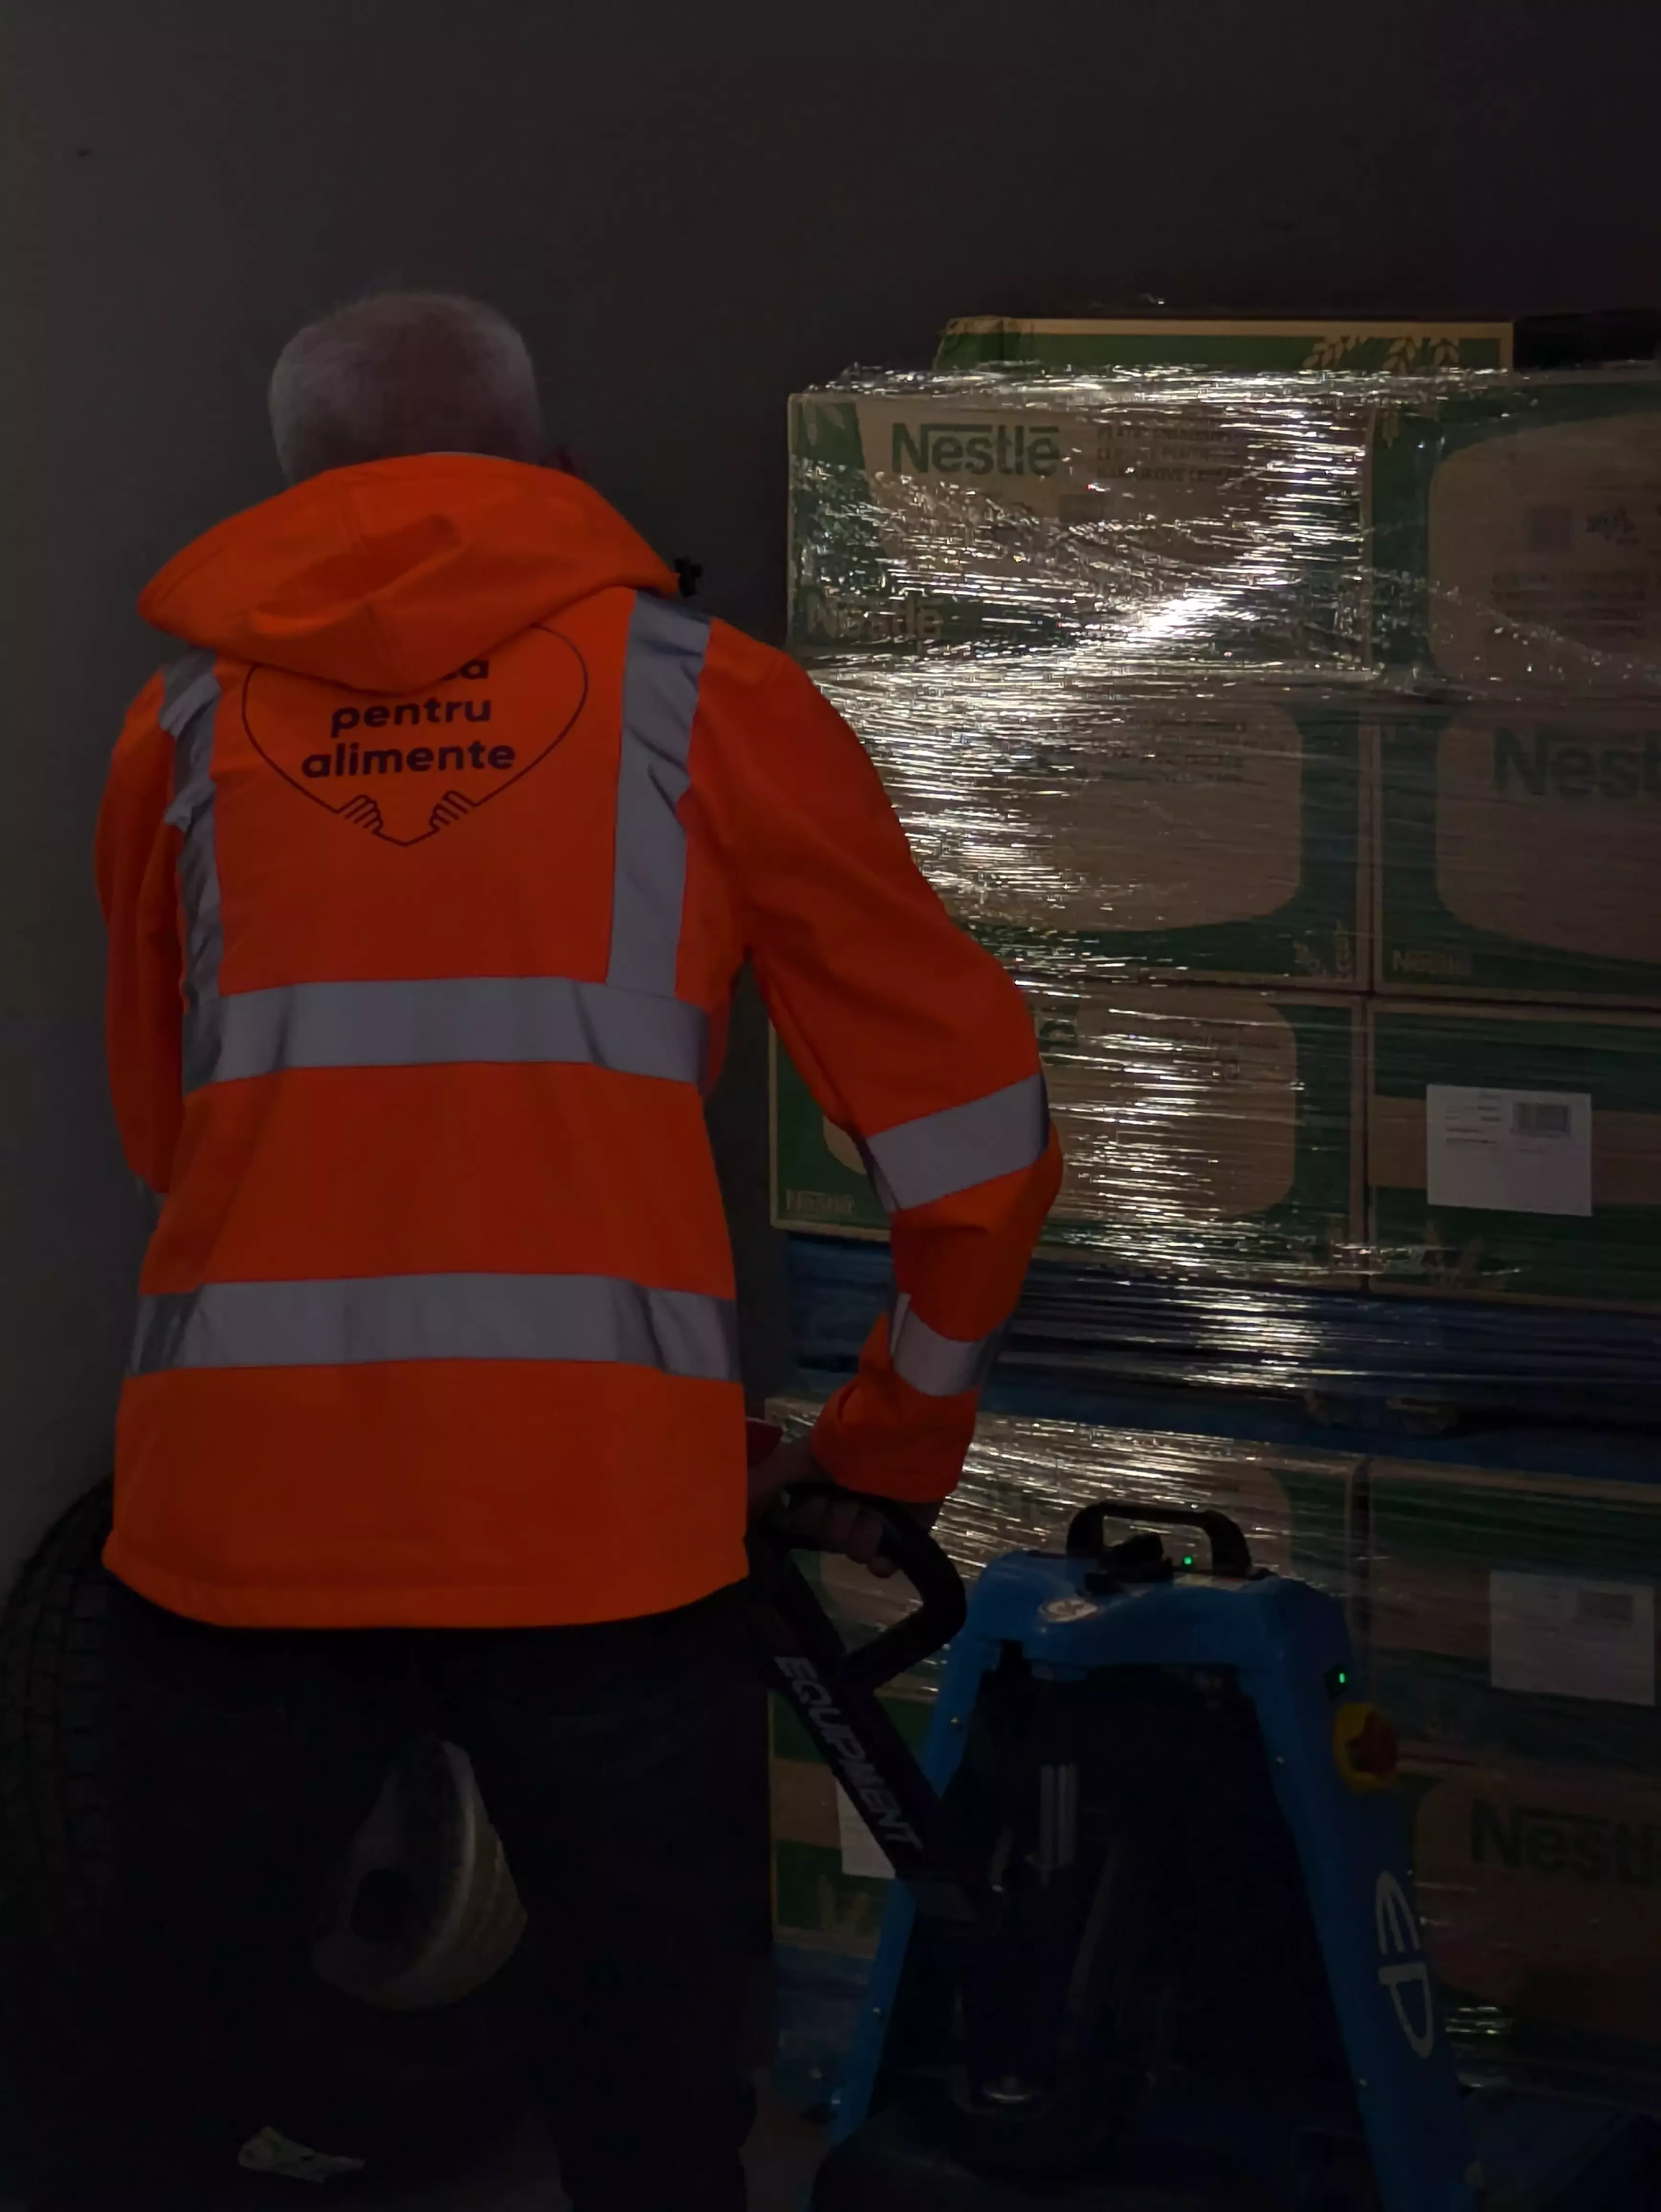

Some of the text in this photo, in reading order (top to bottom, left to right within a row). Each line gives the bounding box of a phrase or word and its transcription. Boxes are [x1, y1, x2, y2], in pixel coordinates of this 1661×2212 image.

[332, 697, 491, 737] pentru
[302, 741, 515, 777] alimente
[1494, 728, 1661, 798] Nest
[774, 1656, 924, 1851] EQUIPMENT
[1473, 1799, 1661, 1885] Nestl
